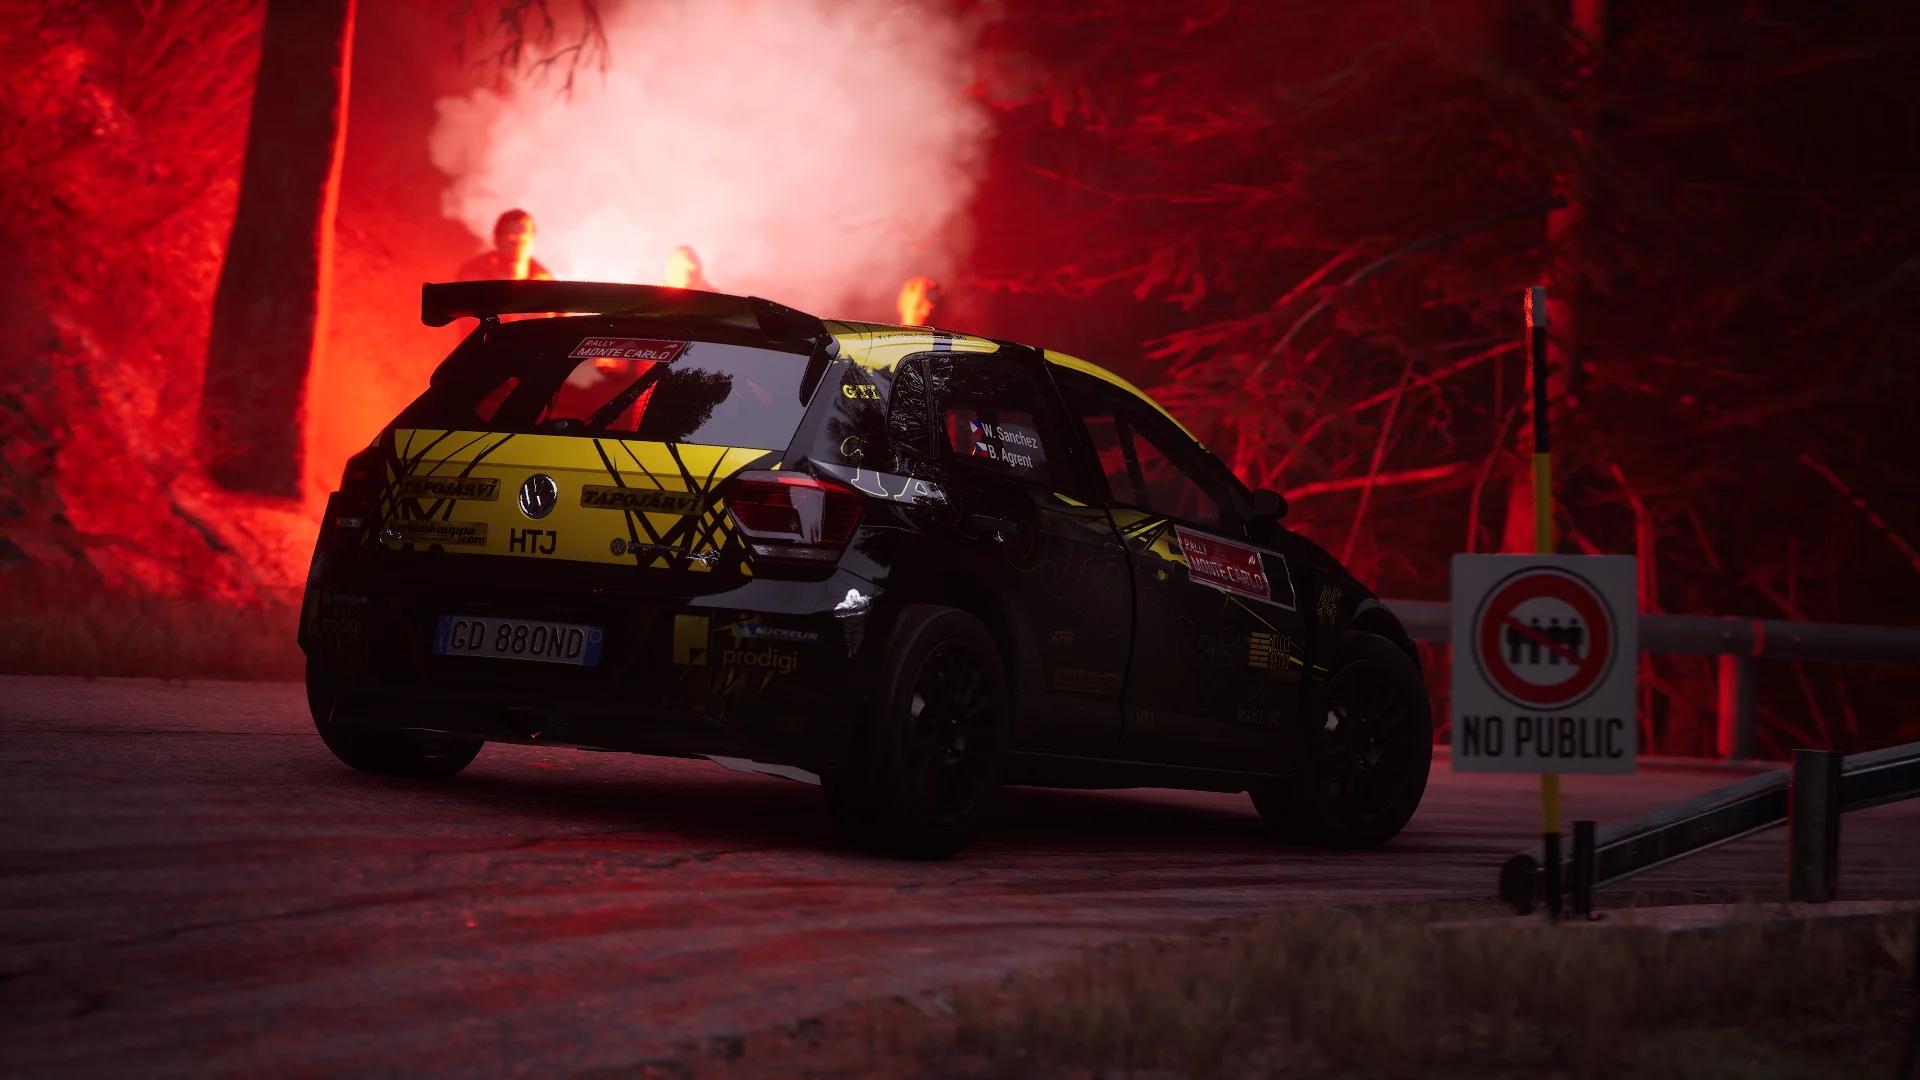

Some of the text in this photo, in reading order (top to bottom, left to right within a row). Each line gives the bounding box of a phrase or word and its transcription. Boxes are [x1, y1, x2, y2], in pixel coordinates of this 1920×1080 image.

[577, 348, 670, 360] MONTE CARLO
[981, 422, 1039, 449] W. Sanchez
[987, 444, 1034, 469] B. Agrent
[509, 528, 557, 555] HTJ
[1184, 538, 1207, 555] RALLY
[1190, 556, 1264, 590] MONTE CARLO
[452, 620, 487, 650] GD
[495, 623, 584, 659] 880ND
[755, 626, 819, 640] MICHELIN
[723, 646, 798, 675] prodigi
[1462, 716, 1625, 759] NO PUBLIC
